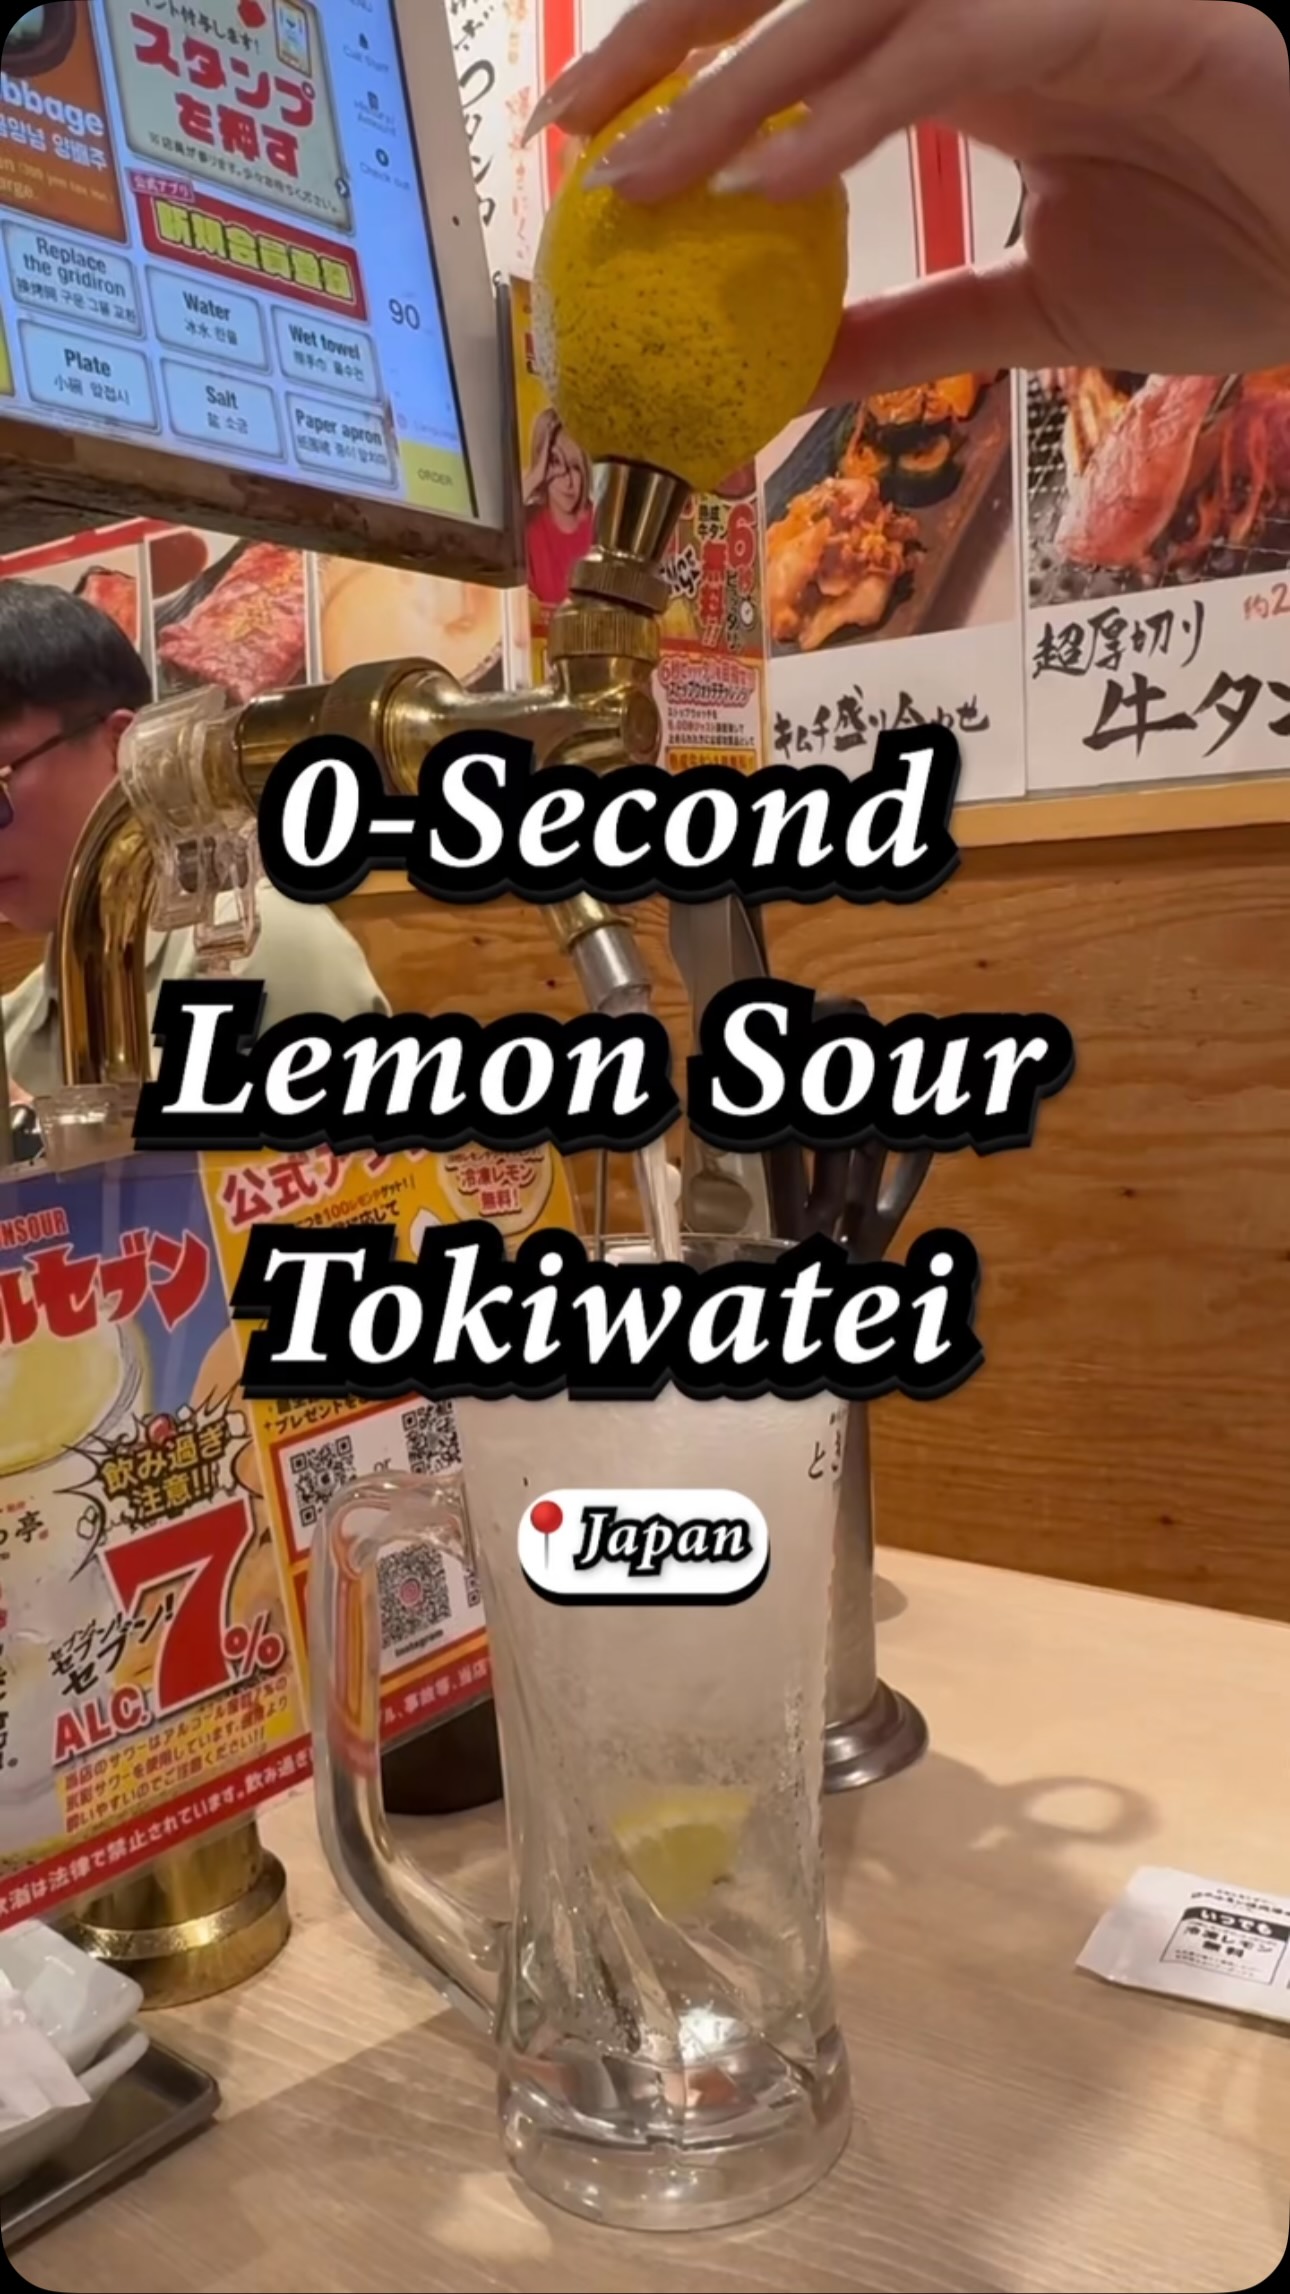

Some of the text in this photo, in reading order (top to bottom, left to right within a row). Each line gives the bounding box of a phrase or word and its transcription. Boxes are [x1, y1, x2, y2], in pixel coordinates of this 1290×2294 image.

[130, 12, 315, 127] スタンプ
[173, 91, 299, 178] を押す
[36, 236, 107, 275] Replace
[23, 253, 126, 298] the gridiron
[183, 291, 231, 321] Water
[389, 298, 420, 330] 90
[289, 324, 361, 361] Wet towel
[64, 348, 112, 378] Plate
[205, 385, 239, 411] Salt
[295, 409, 384, 448] Paper apron
[416, 467, 454, 487] ORDER
[1032, 600, 1205, 680] 超厚切り
[102, 1425, 226, 1494] 飲み過ぎ
[132, 1470, 213, 1517] 注意!!
[53, 1686, 149, 1763] ALC.
[0, 1746, 314, 1918] 酒は法律で禁止されています。飲み過ぎ
[1201, 1908, 1273, 1936] いつでも
